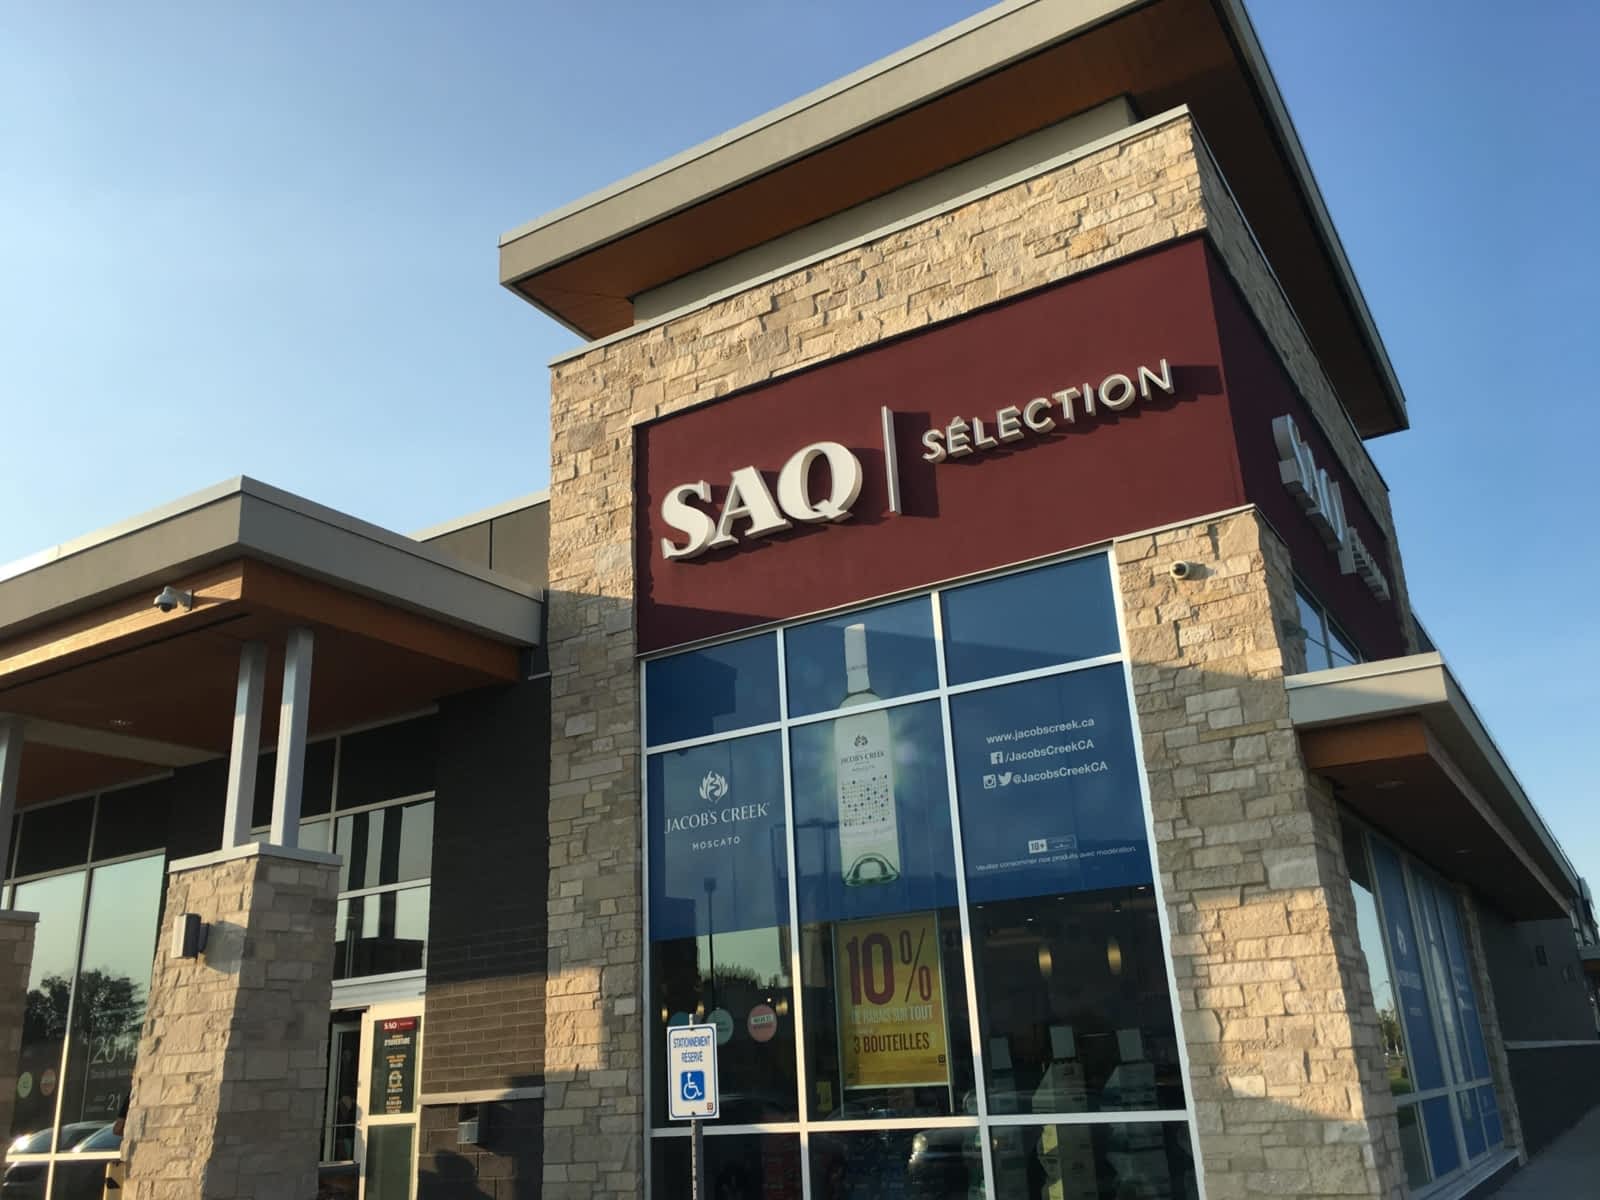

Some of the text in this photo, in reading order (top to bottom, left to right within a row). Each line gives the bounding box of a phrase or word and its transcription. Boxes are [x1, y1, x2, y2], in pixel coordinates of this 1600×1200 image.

[661, 358, 1175, 560] SAQ SÉLECTION
[986, 718, 1095, 744] www.jacobscreek.ca
[1005, 739, 1094, 762] /JacobsCreekCA
[1013, 761, 1108, 784] @JacobsCreekCA
[721, 802, 767, 823] CREEK
[692, 835, 741, 850] MOSCATO
[846, 927, 932, 1006] 10%
[910, 1004, 933, 1021] TOUT
[854, 1032, 930, 1055] 3 BOUTEILLES
